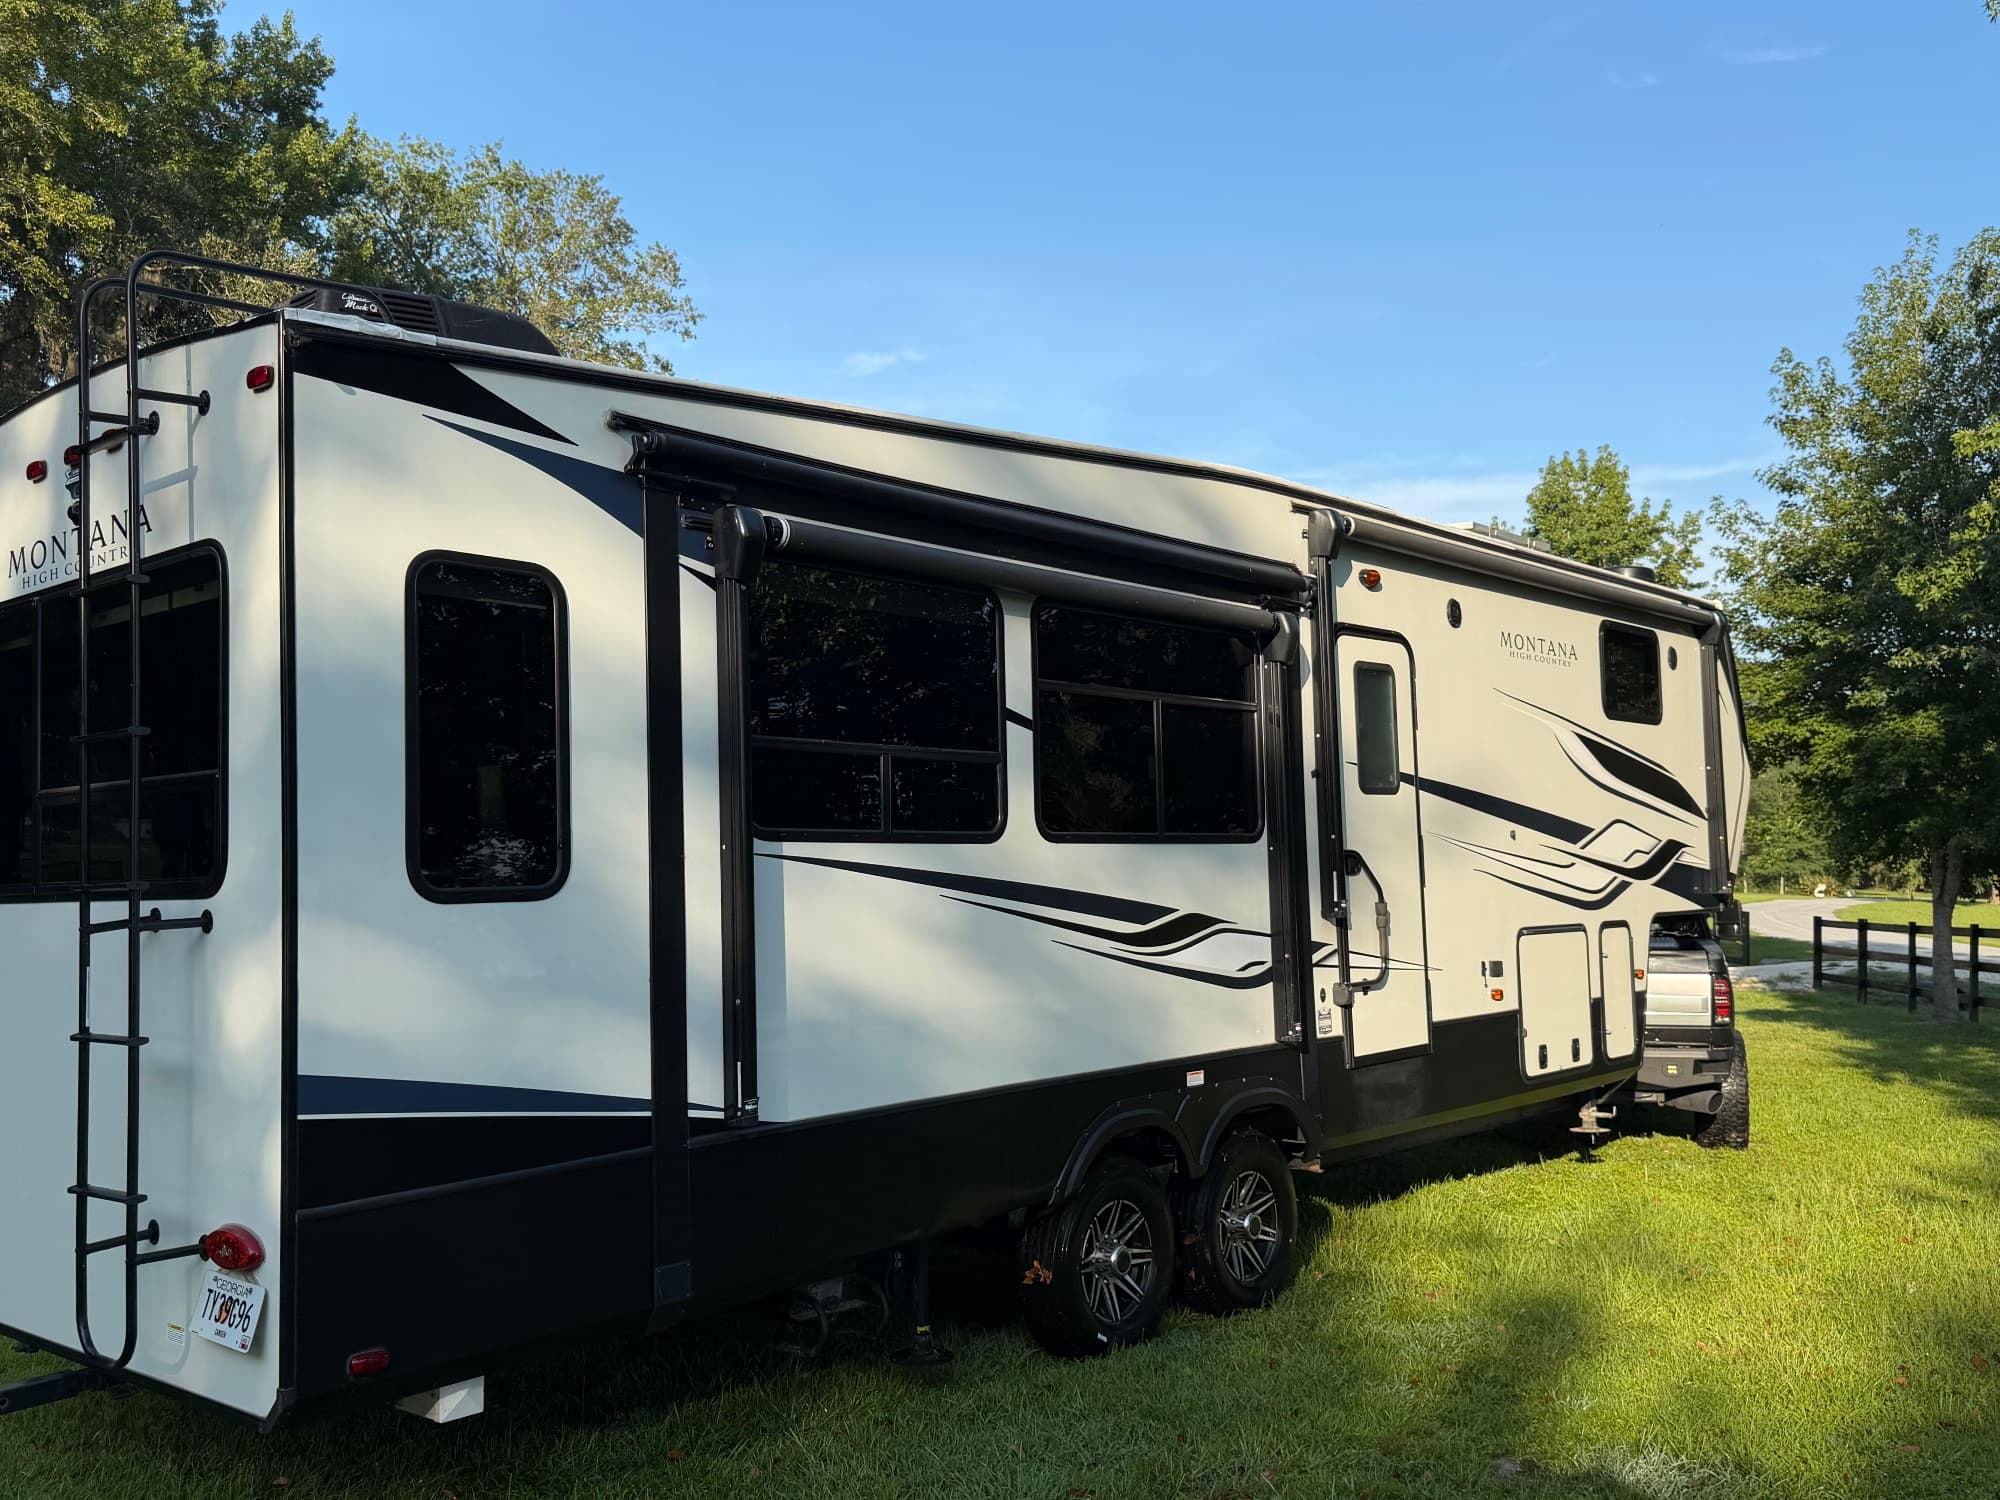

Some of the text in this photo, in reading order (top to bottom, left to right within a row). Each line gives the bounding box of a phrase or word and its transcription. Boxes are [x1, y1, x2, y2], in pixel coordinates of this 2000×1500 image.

[8, 504, 153, 578] MONTANA
[22, 567, 59, 590] HIGH
[1500, 631, 1578, 661] MONTANA
[1509, 650, 1572, 668] HIGH COUNTRY
[215, 1278, 250, 1298] GEORGIA
